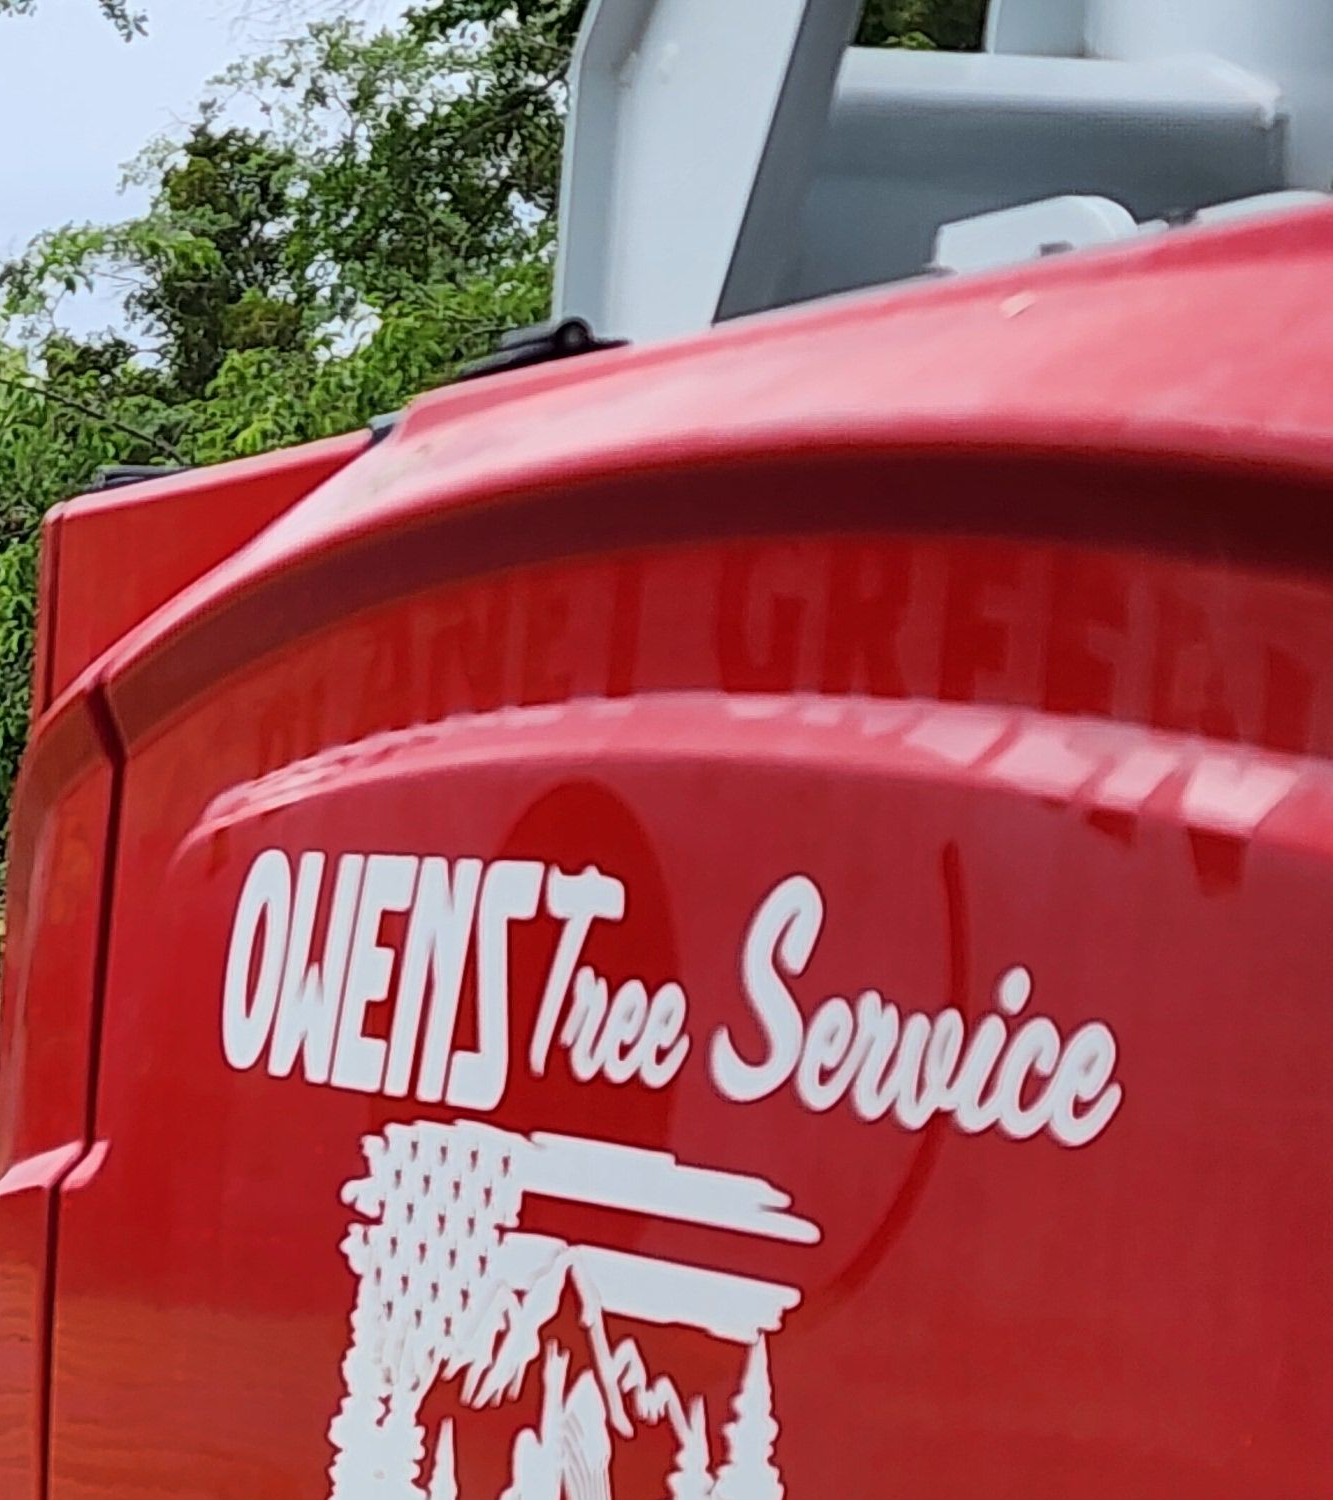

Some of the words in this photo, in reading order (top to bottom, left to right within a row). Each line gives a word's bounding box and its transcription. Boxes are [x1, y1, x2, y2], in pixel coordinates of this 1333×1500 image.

[221, 848, 545, 1112] OWENS
[530, 865, 690, 1088] Tree
[710, 875, 1123, 1147] Service
